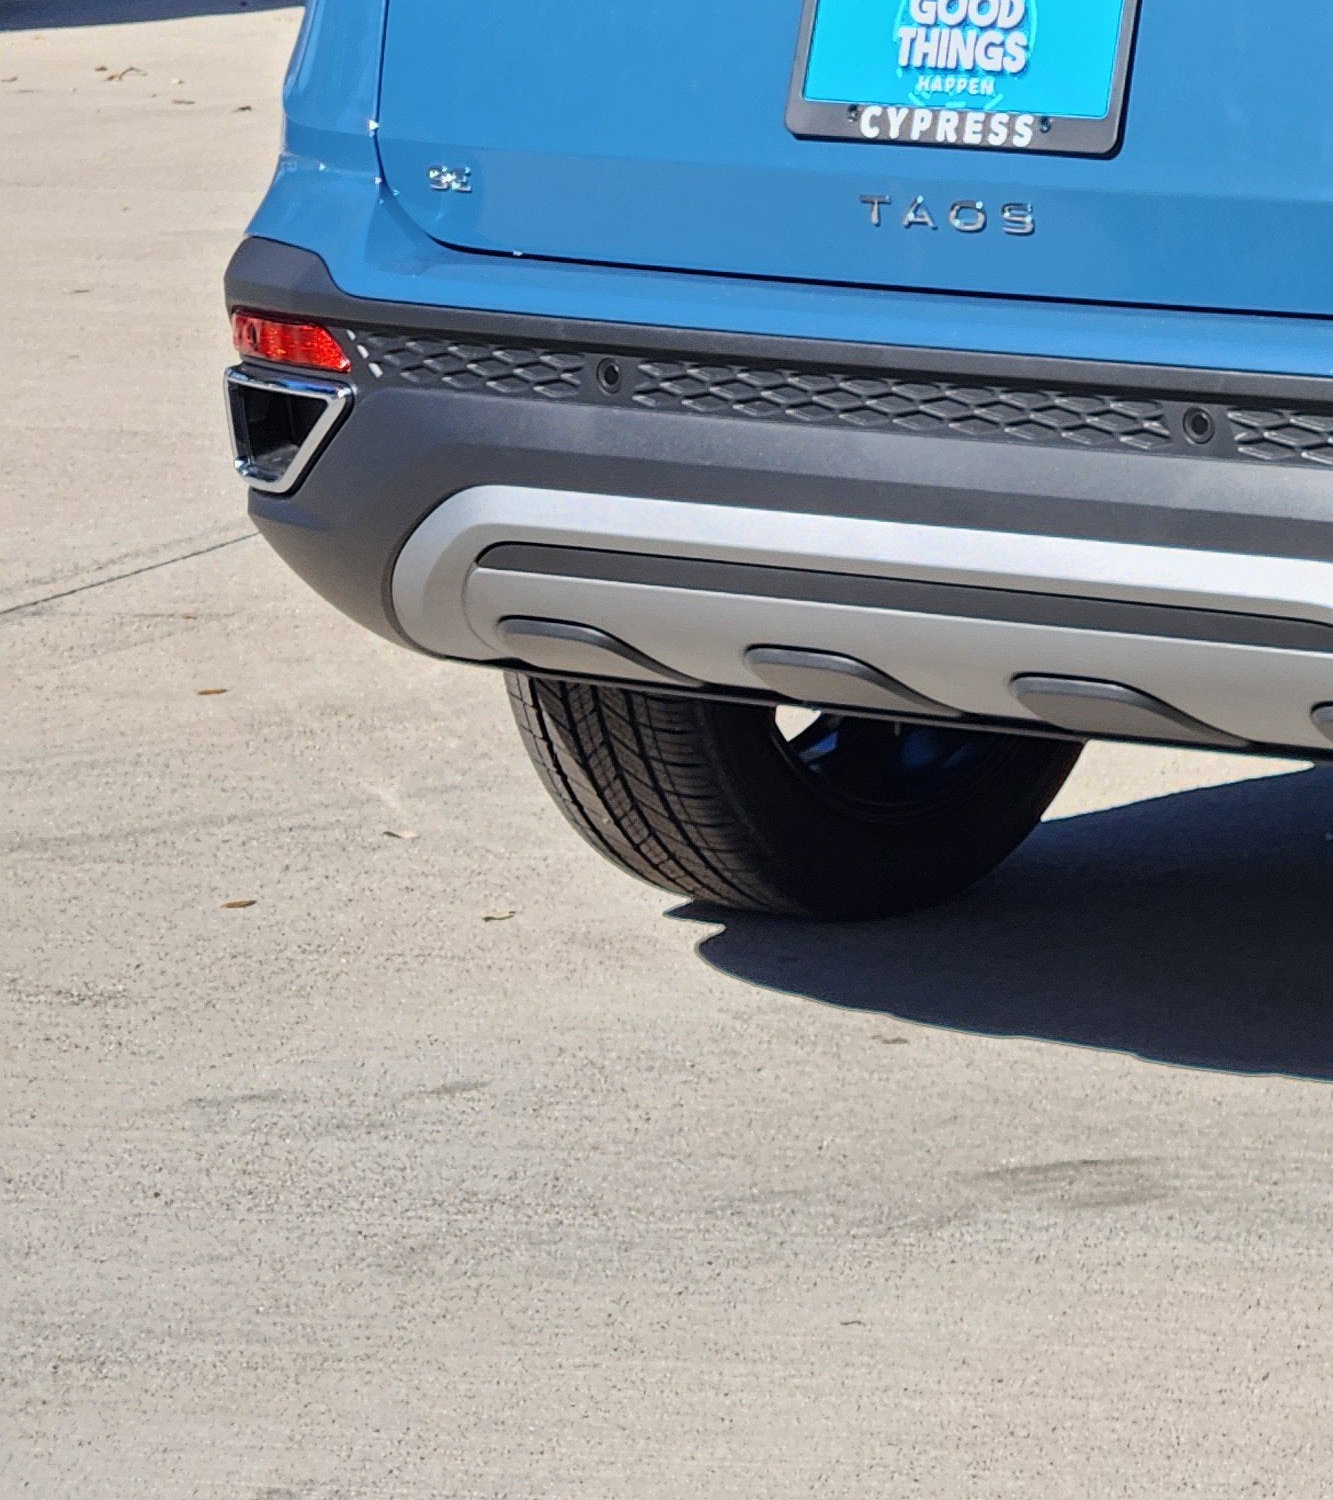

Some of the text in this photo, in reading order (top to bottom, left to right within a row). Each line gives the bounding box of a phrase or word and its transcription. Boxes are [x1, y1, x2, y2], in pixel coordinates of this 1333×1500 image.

[898, 27, 1028, 73] THINGS
[917, 75, 995, 95] HAPPEN
[859, 106, 1034, 148] CYPRESS
[859, 194, 1035, 235] TAOS
